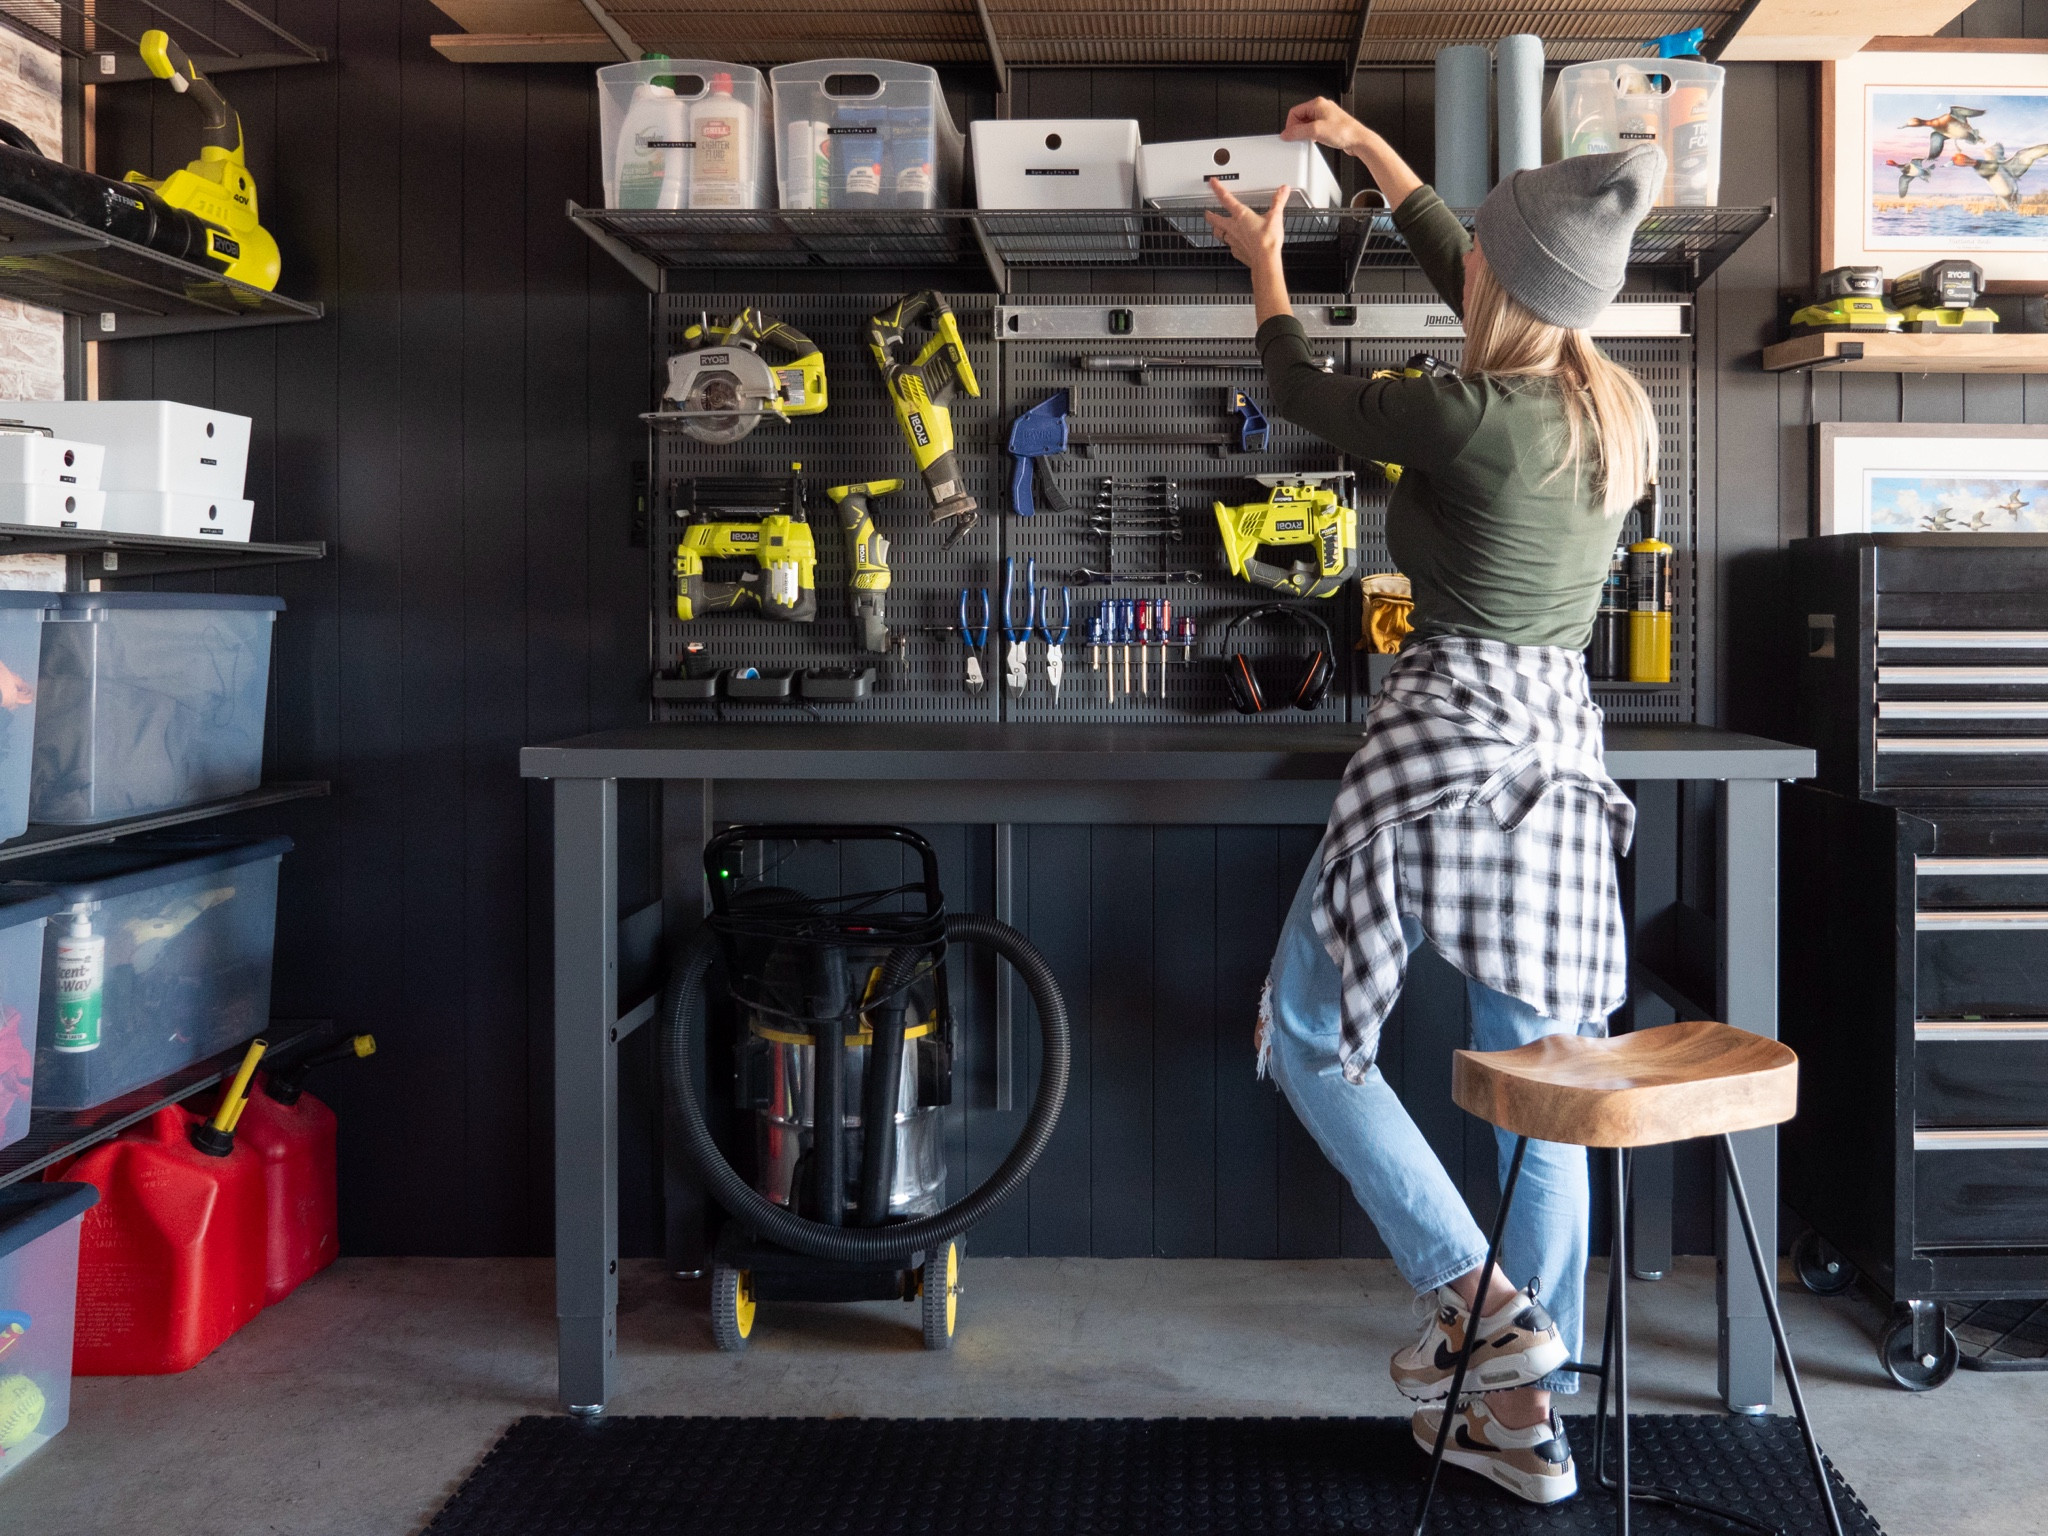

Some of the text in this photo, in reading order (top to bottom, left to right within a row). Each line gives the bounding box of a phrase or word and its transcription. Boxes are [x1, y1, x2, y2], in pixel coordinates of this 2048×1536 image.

[1692, 123, 1708, 136] TIR
[233, 194, 249, 205] 40V
[214, 235, 239, 258] RYOBI
[1947, 270, 1970, 279] RYOBI
[1424, 315, 1463, 326] JOHNSO
[701, 356, 729, 364] RYOBI
[910, 415, 928, 446] RYOBI
[1277, 521, 1302, 529] RYOBI
[733, 533, 758, 541] RYOBI
[59, 965, 90, 979] cent-
